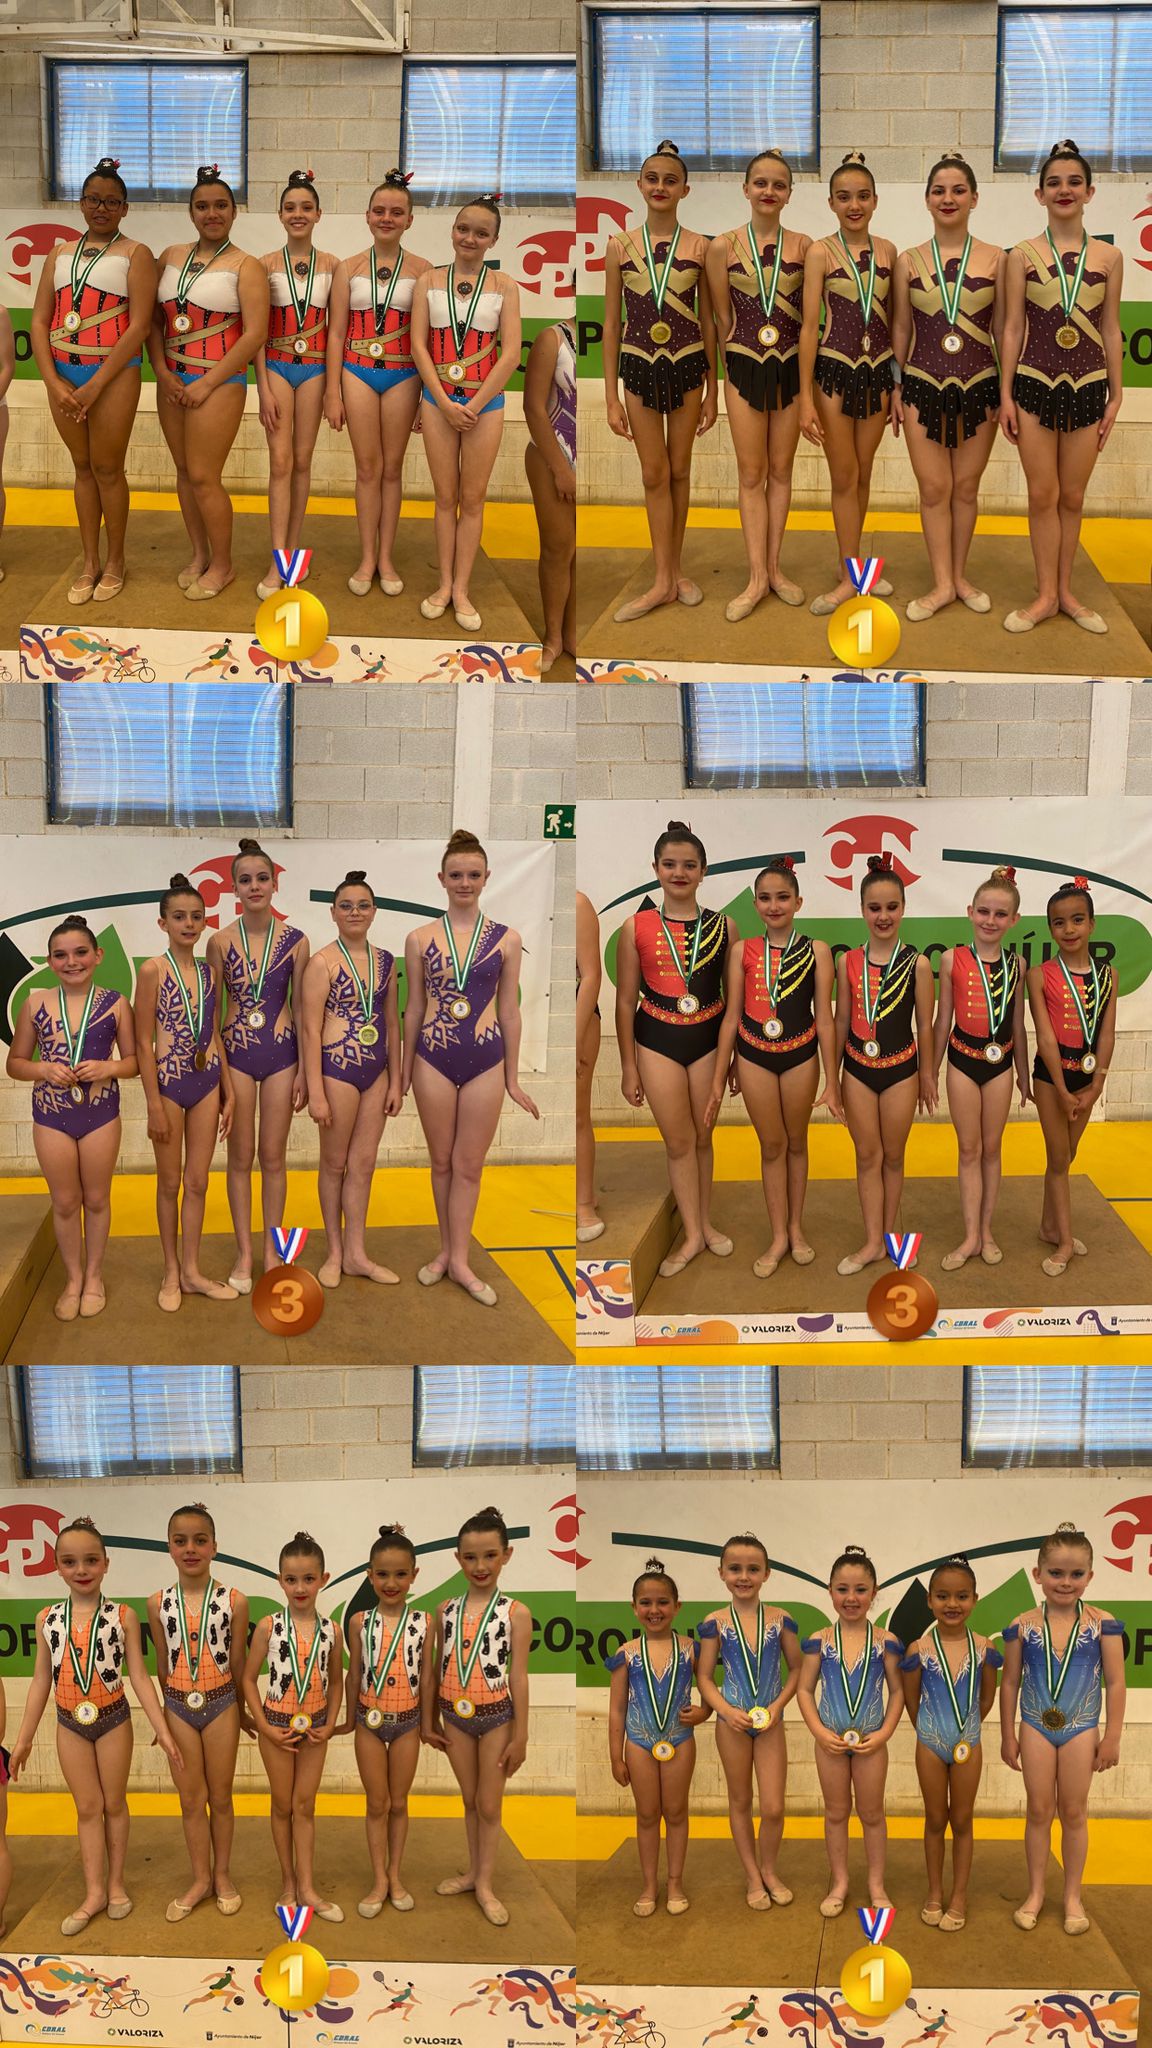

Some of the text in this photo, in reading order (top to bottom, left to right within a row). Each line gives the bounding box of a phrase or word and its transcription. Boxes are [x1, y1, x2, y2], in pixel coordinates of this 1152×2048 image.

[1027, 1318, 1071, 1326] VALORIZA
[751, 1325, 796, 1333] VALORIZA
[117, 2028, 164, 2038] VALORIZA
[414, 2037, 463, 2046] VALORIZA
